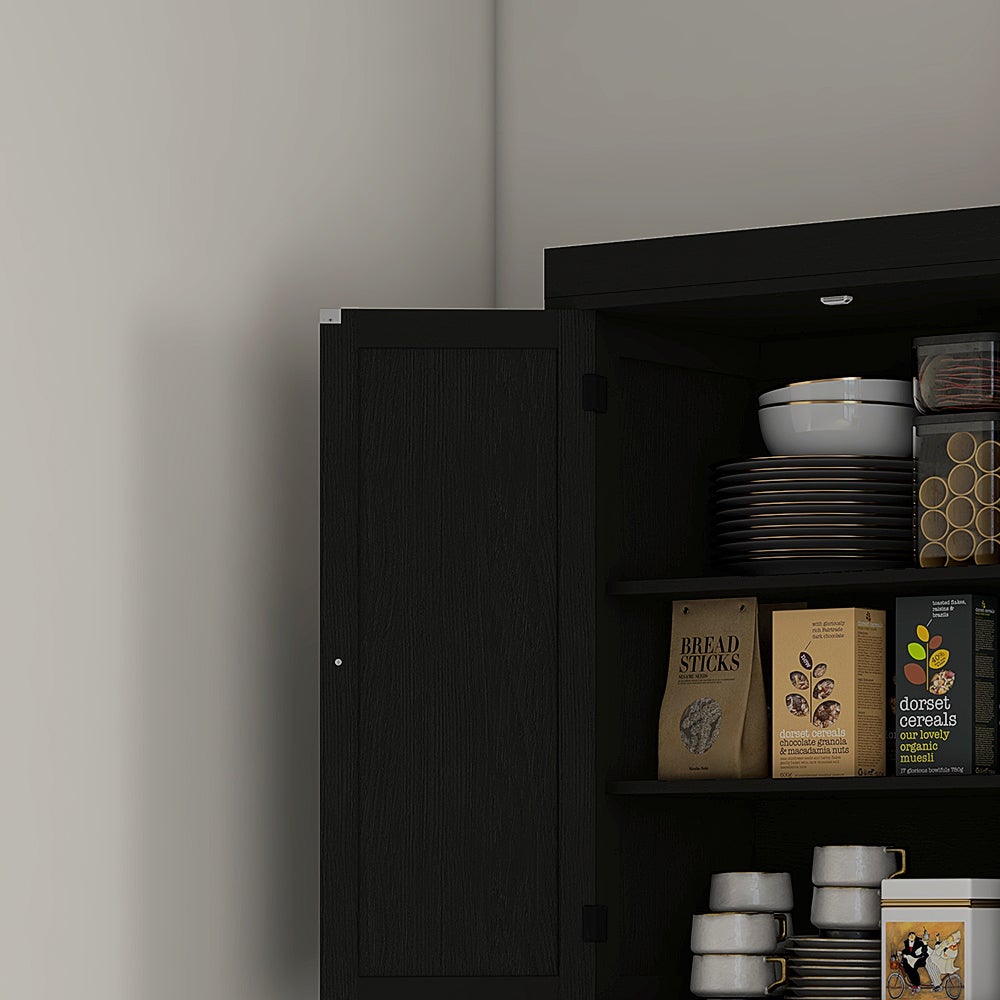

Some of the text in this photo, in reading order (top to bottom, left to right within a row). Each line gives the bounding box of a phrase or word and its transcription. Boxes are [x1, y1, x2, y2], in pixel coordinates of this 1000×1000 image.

[680, 635, 740, 655] BREAD
[679, 653, 740, 673] STICKS
[899, 695, 951, 712] dorset
[899, 711, 958, 728] cereals
[779, 728, 846, 739] dorset cereals
[900, 732, 919, 740] our
[920, 729, 950, 741] lovely
[779, 738, 848, 748] chocolate granola
[900, 741, 938, 753] organic
[779, 746, 850, 755] & macadamia nuts
[900, 752, 934, 763] muesli
